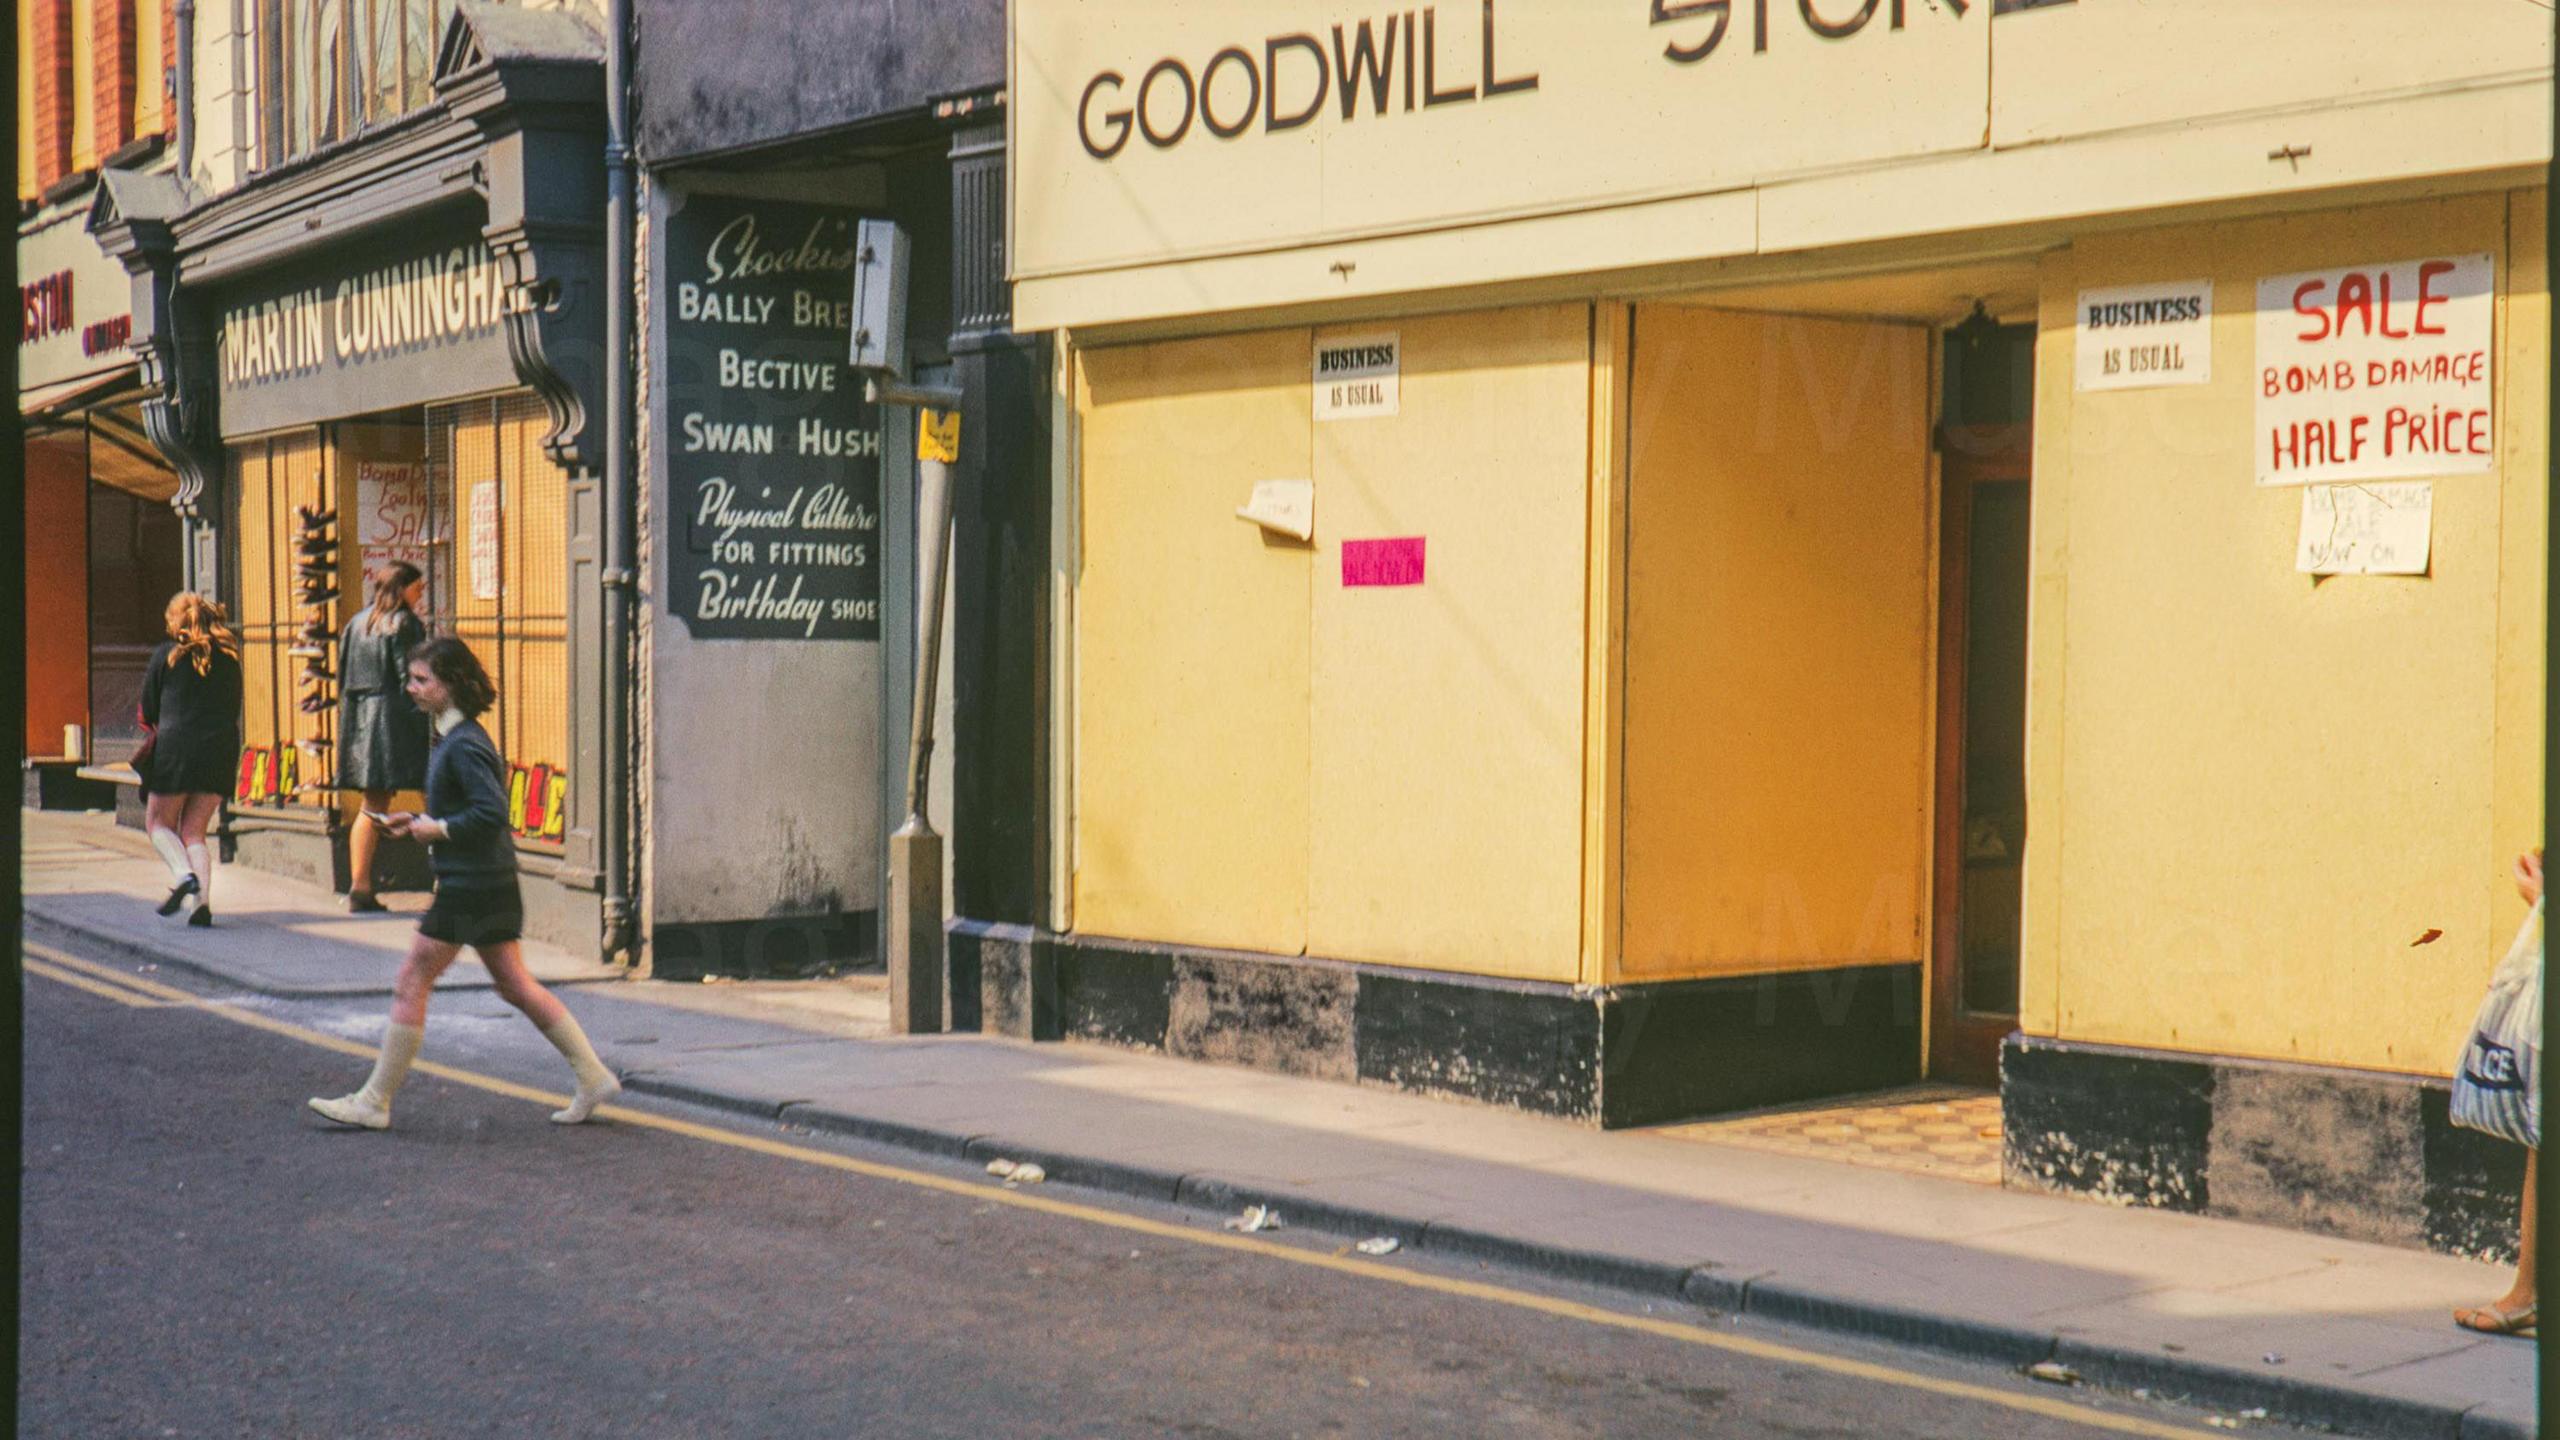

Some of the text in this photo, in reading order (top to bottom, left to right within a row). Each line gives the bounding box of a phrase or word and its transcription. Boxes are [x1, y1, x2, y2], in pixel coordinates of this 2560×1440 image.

[1078, 0, 1540, 160] GOODWILL
[679, 282, 775, 325] BALLY
[2088, 296, 2202, 330] BUSINESS
[2292, 260, 2456, 342] SALE
[225, 286, 324, 384] MARTIN
[1320, 343, 1394, 373] BUSINESS
[719, 348, 837, 392] BECTIVE
[2103, 343, 2185, 375] AS USUAL
[2262, 351, 2485, 398] BOMB DAMAGE
[1331, 383, 1384, 408] AS USUAL
[683, 411, 774, 455] SWAN
[798, 417, 880, 457] HUSH
[2272, 415, 2370, 471] HALF
[697, 476, 804, 543] Physical
[712, 541, 866, 566] FOR FITTINGS
[697, 568, 880, 638] Birthday SHOE
[508, 764, 567, 840] ALE
